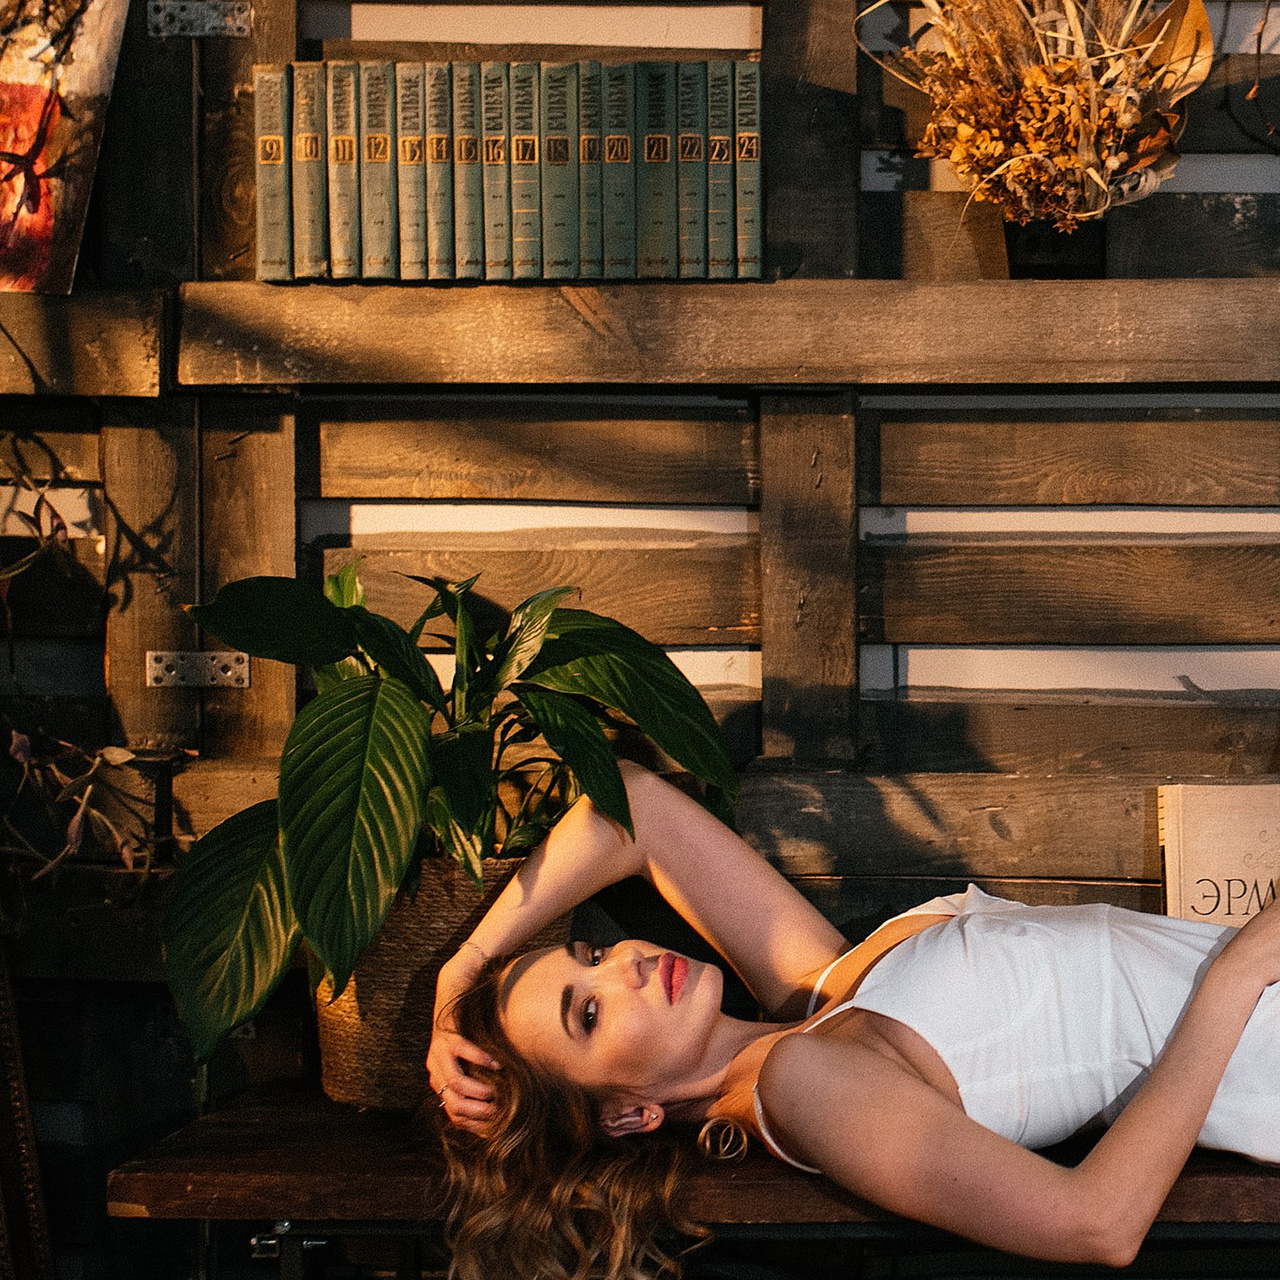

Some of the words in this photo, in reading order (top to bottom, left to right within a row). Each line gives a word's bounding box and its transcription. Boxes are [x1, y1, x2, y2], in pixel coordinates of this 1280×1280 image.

[485, 73, 504, 131] БАЛЬЗАК
[514, 72, 534, 131] БАЛЬЗАК
[548, 72, 568, 131] БАЛЬЗАК
[709, 72, 729, 131] БАЛЬЗАК
[738, 72, 757, 128] БАЛЬЗАК
[263, 139, 281, 161] 9
[369, 139, 386, 161] 12
[403, 139, 421, 161] 13
[430, 139, 447, 161] 14
[461, 139, 478, 161] 15
[487, 139, 504, 161] 16
[517, 139, 535, 161] 17
[583, 139, 601, 161] 19
[608, 139, 628, 161] 20
[648, 139, 667, 161] 21
[682, 139, 701, 161] 22
[710, 139, 729, 161] 23
[739, 139, 758, 161] 24
